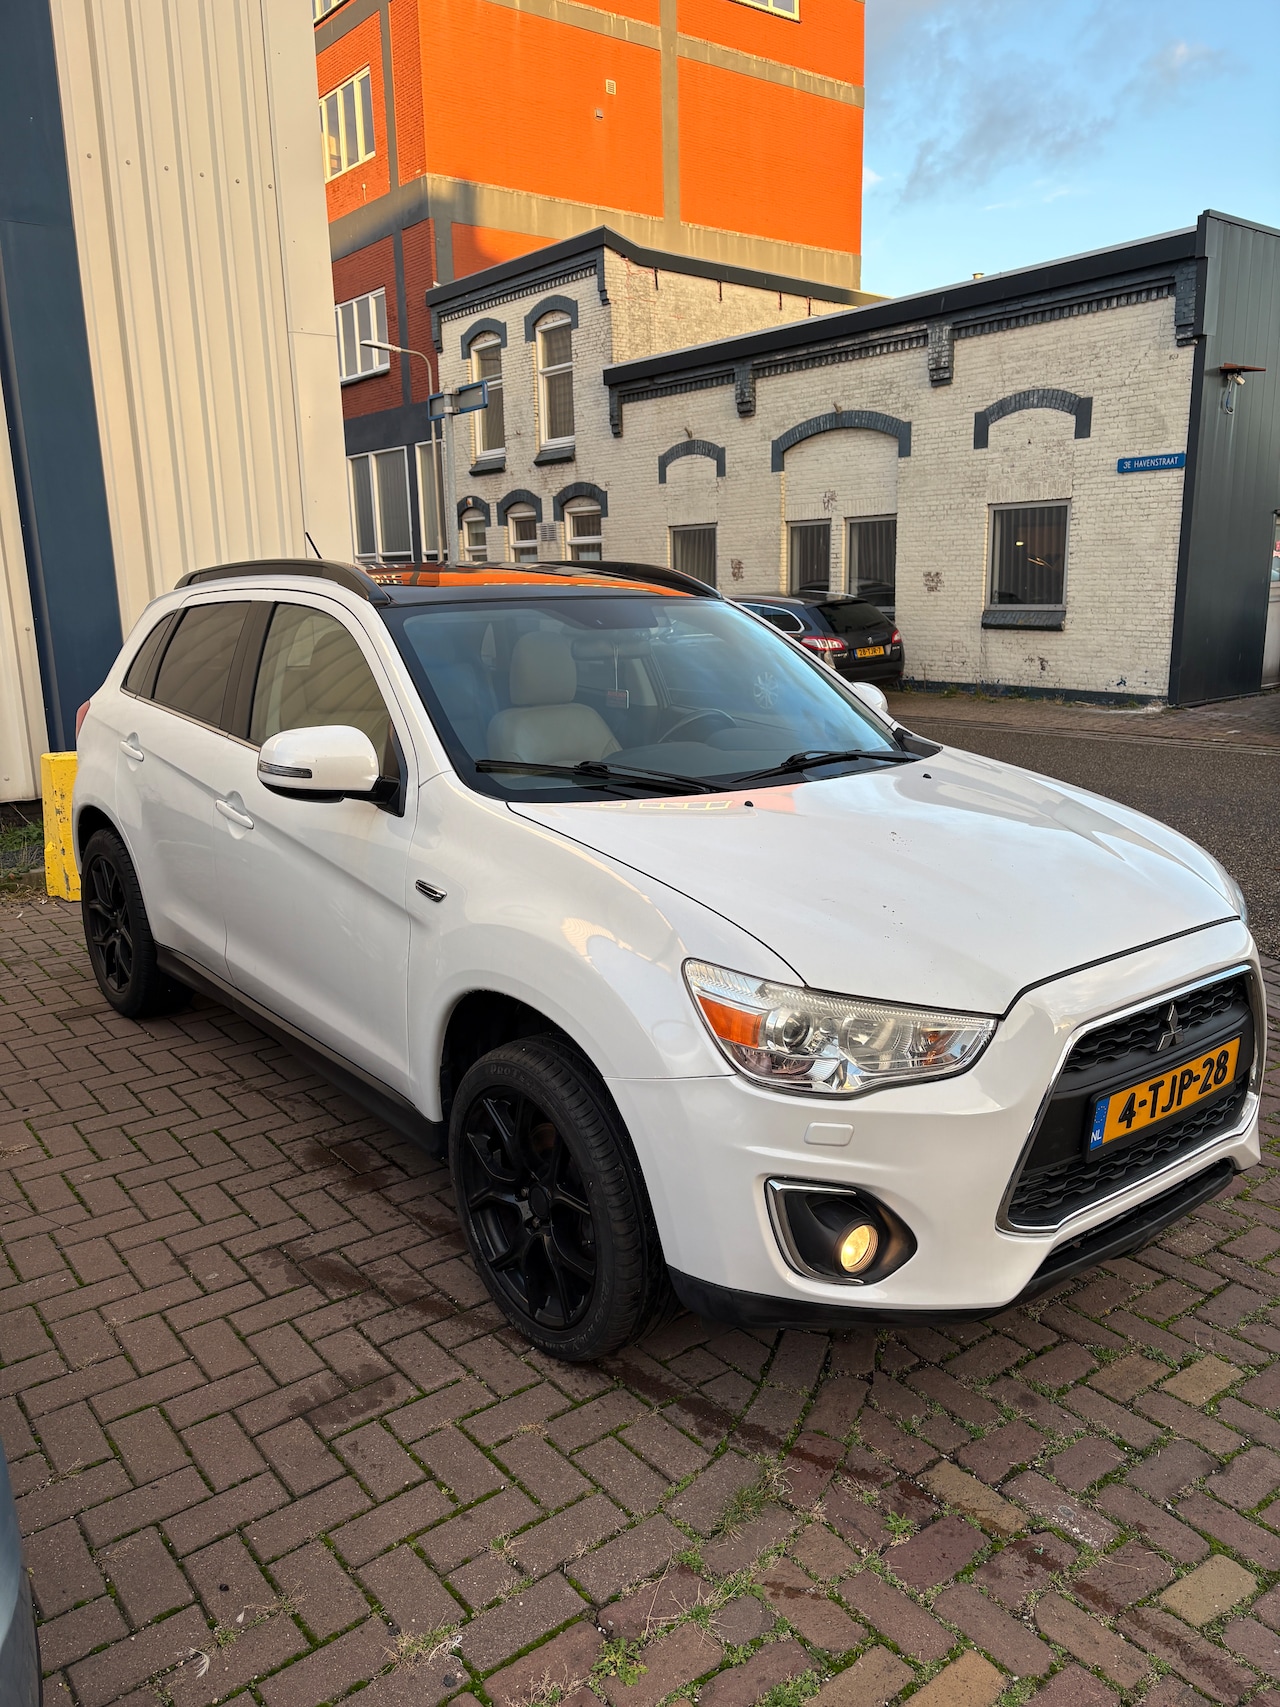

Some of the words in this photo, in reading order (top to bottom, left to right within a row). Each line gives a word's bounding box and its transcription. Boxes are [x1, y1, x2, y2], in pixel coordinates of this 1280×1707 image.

[1123, 461, 1132, 469] 3E
[1134, 456, 1178, 467] HAVENSTRAAT
[1118, 1050, 1229, 1129] 4-TJP-28
[1090, 1129, 1102, 1143] NL
